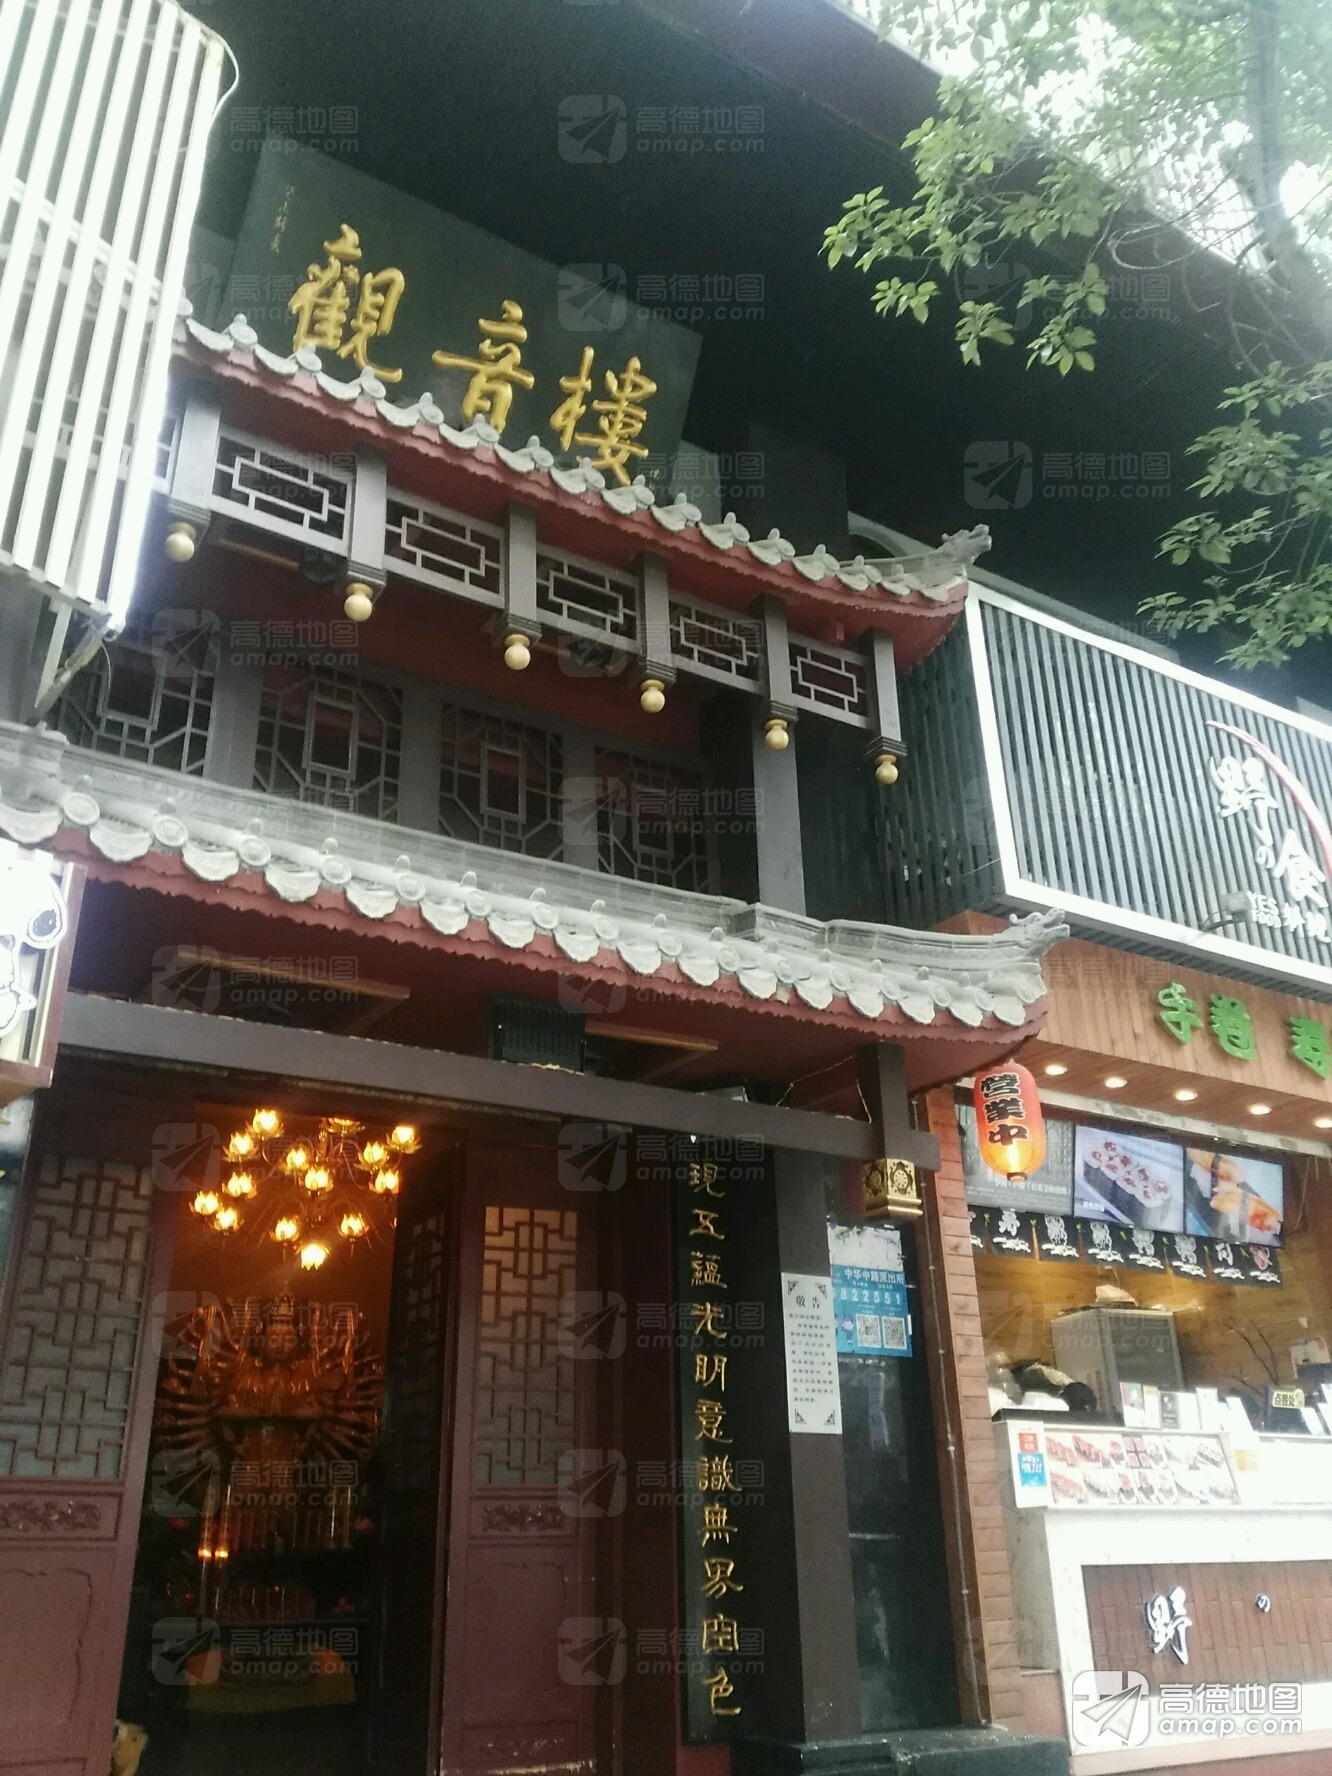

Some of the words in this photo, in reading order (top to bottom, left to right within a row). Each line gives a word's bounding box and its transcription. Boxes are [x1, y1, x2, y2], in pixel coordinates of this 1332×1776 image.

[289, 223, 658, 485] 觀音樓
[1247, 891, 1279, 916] YES
